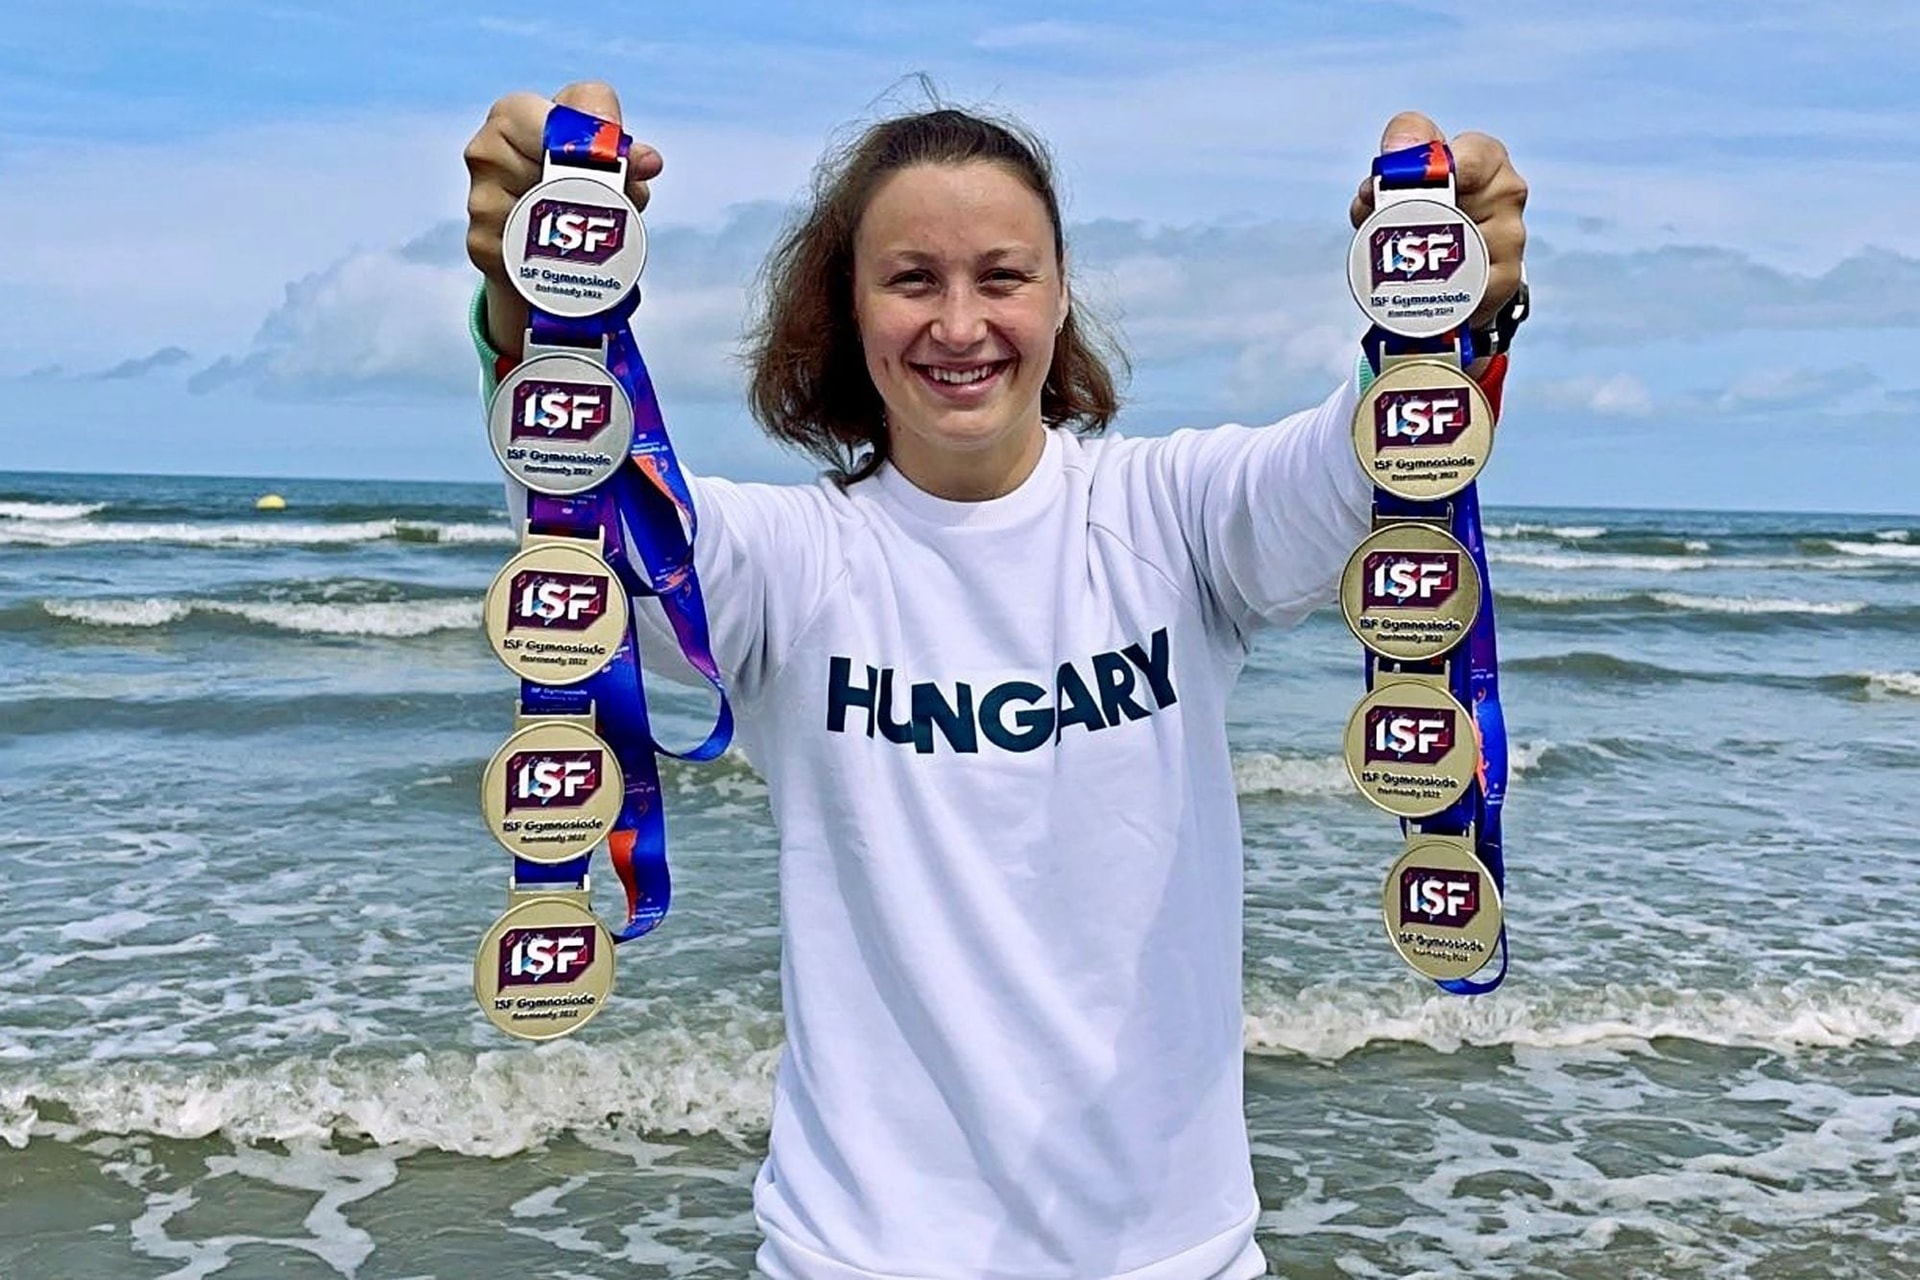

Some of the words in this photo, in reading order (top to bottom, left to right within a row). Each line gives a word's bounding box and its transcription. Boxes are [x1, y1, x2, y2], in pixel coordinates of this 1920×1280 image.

[538, 211, 616, 252] ISF
[1382, 233, 1454, 273] ISF
[520, 266, 539, 279] ISF
[1371, 296, 1389, 307] ISF
[524, 392, 600, 430] ISF
[1387, 399, 1459, 437] ISF
[507, 448, 527, 460] ISF
[1375, 460, 1393, 470] ISF
[1374, 562, 1448, 598] ISF
[521, 582, 597, 620] ISF
[1360, 618, 1379, 629] ISF
[503, 639, 523, 649] ISF
[827, 627, 1177, 754] HUNGARY
[1376, 718, 1444, 753] ISF
[518, 761, 591, 799] ISF
[1362, 772, 1379, 783] ISF
[503, 821, 522, 832] ISF
[1410, 880, 1470, 916] ISF
[511, 937, 584, 976] ISF
[495, 999, 514, 1010] ISF
